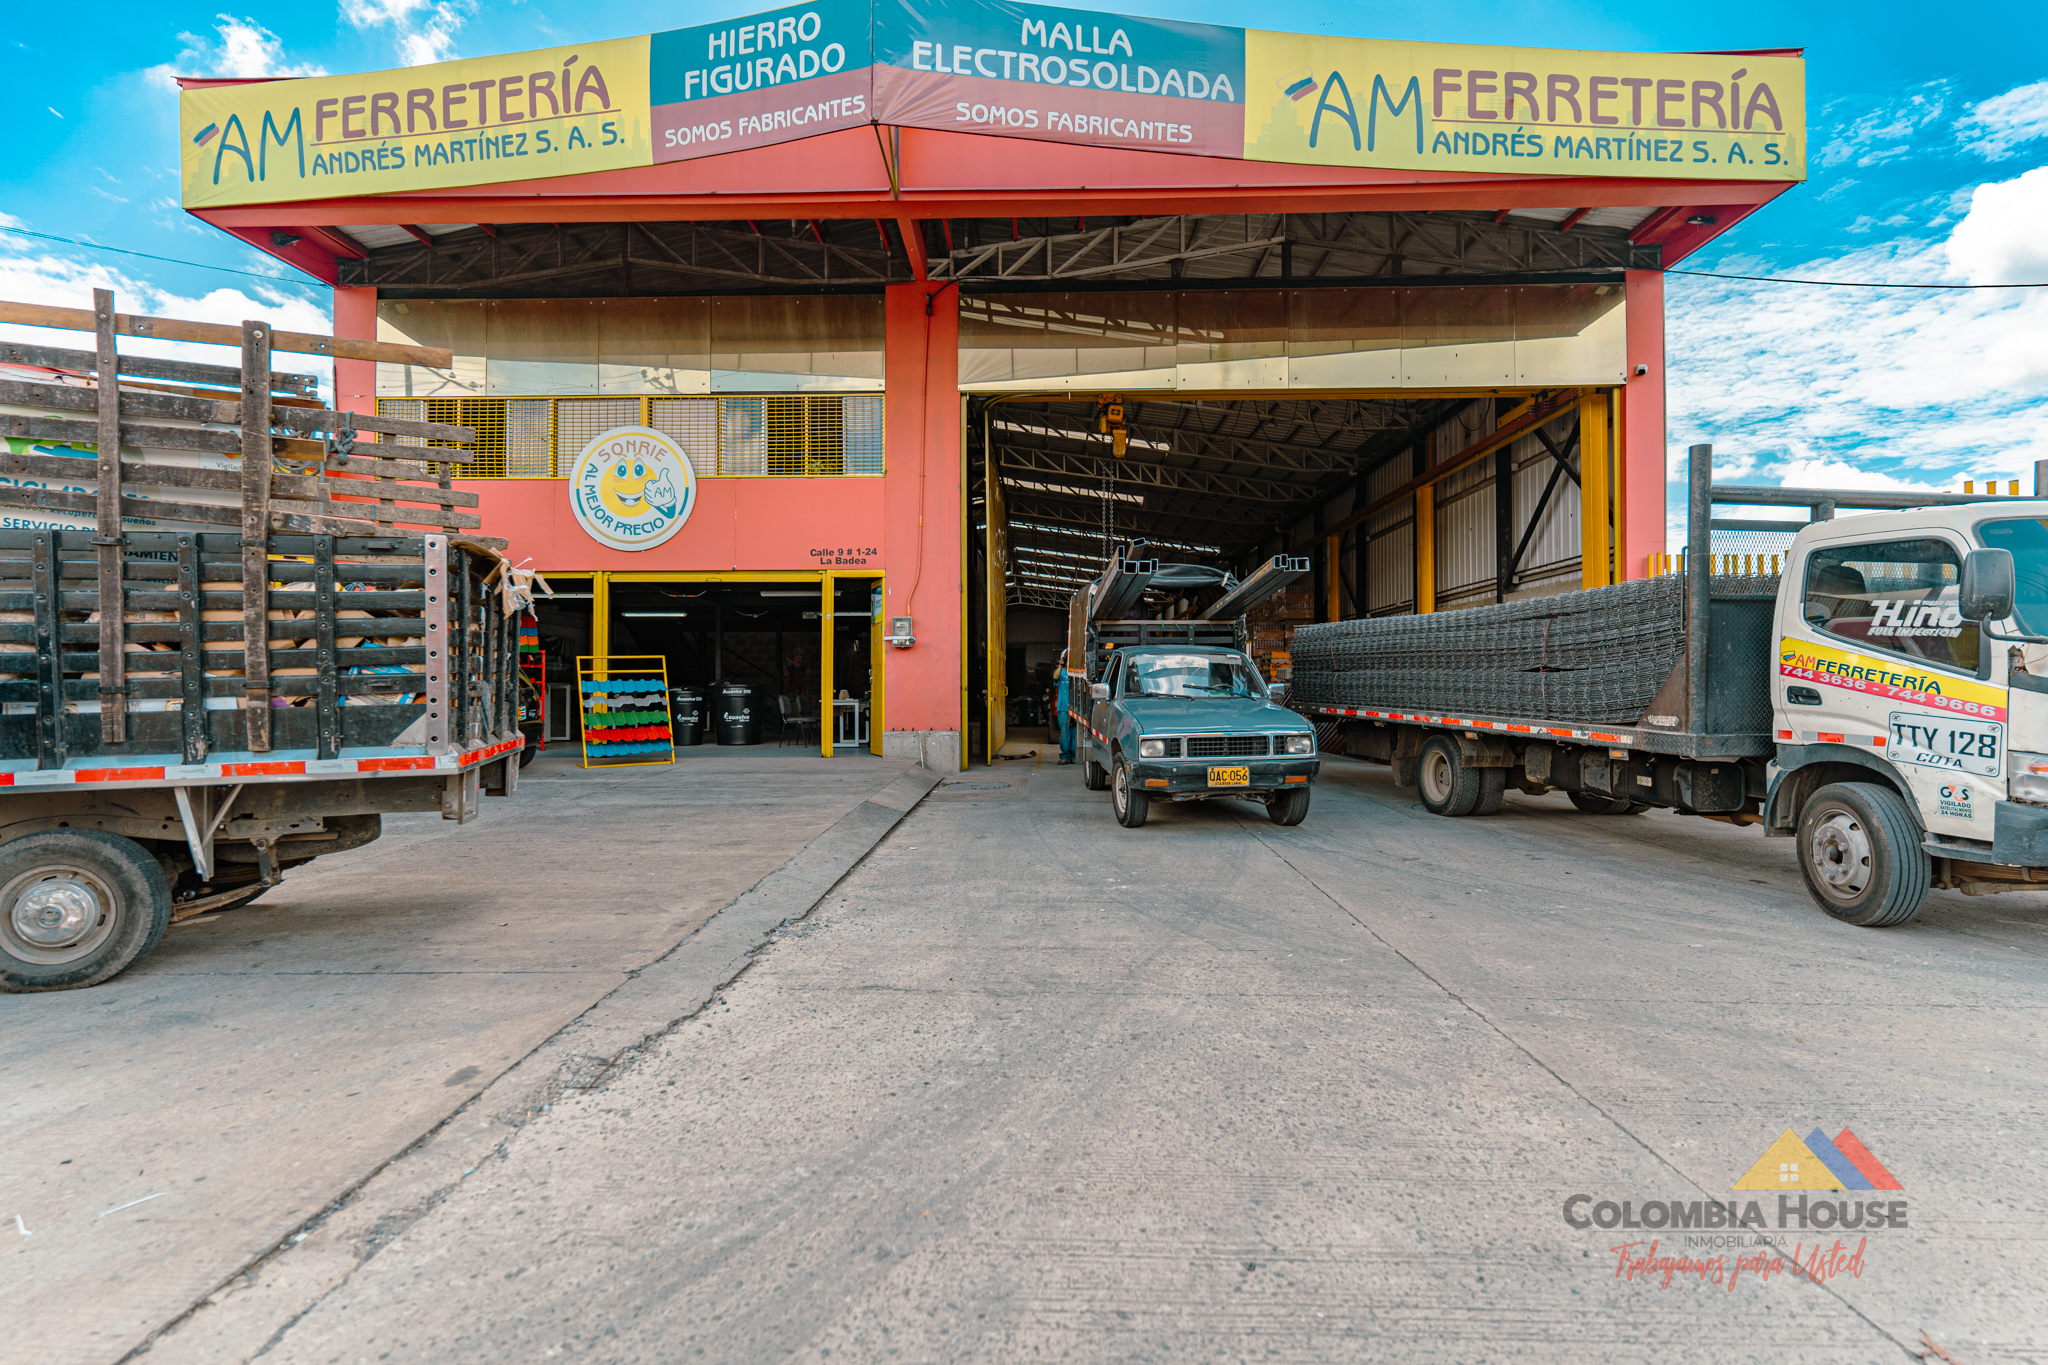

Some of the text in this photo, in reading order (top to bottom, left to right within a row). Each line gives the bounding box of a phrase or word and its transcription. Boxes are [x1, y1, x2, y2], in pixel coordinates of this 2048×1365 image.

[707, 12, 821, 61] HIERRO
[1021, 18, 1133, 57] MALLA
[684, 43, 846, 99] FIGURADO
[912, 40, 1235, 102] ELECTROSOLDADA
[315, 54, 612, 142] FERRETERÍA
[1309, 71, 1424, 154] AM
[1433, 68, 1783, 131] FERRETERÍA
[664, 94, 866, 148] SOMOS FABRICANTES
[955, 102, 1193, 144] SOMOS FABRICANTES
[213, 107, 306, 186] AM
[312, 121, 625, 176] ANDRÉS MARTÍNEZ S. A. S.
[1432, 127, 1789, 165] ANDRÉS MARTÍNEZ S. A. S.
[216, 462, 242, 470] Vigilad
[598, 440, 668, 463] SONRIE
[585, 463, 598, 481] AL
[585, 485, 614, 528] MEJOR
[654, 487, 672, 498] AM
[122, 516, 156, 526] sueños
[614, 517, 665, 535] PRECIO
[810, 548, 835, 557] Calle
[838, 548, 844, 556] 9
[856, 547, 878, 556] 1-24
[820, 556, 867, 565] La Badea
[1870, 600, 1963, 627] Hino
[1867, 627, 1963, 638] FULL INJECTION
[1783, 665, 1814, 679] 744
[1819, 672, 1866, 690] 3636
[1886, 685, 1927, 703] 744
[1934, 696, 1996, 717] 9666
[1816, 659, 1941, 695] FERRETERÍA
[1892, 723, 1996, 759] TTY 128
[1916, 752, 1963, 768] COTA
[1940, 799, 1971, 808] VIGILADO
